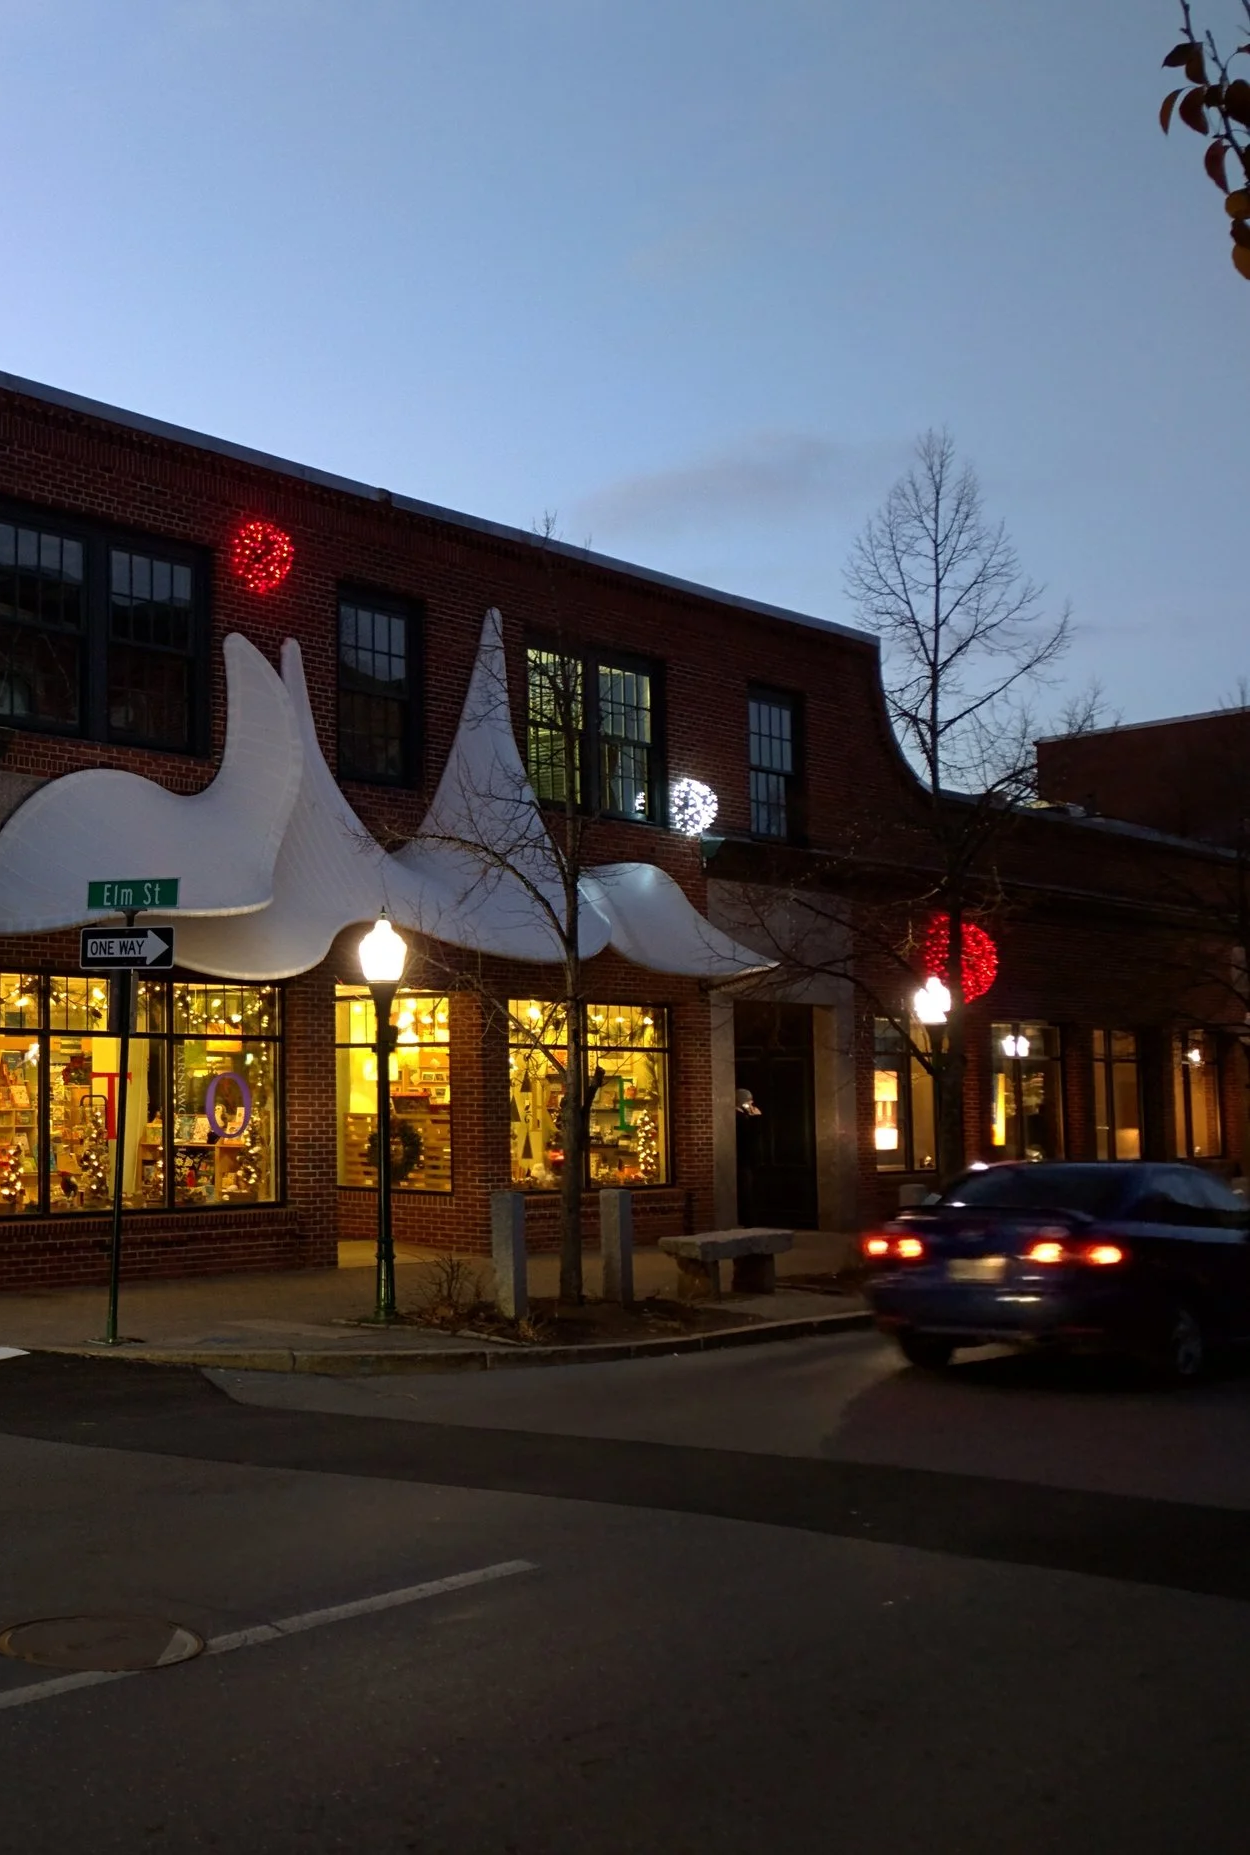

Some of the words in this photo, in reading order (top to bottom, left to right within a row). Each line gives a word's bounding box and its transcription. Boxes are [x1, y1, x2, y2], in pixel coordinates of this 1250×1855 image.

[103, 884, 133, 906] Elm
[143, 882, 161, 905] St
[90, 940, 115, 956] ONE
[119, 940, 145, 956] WAY
